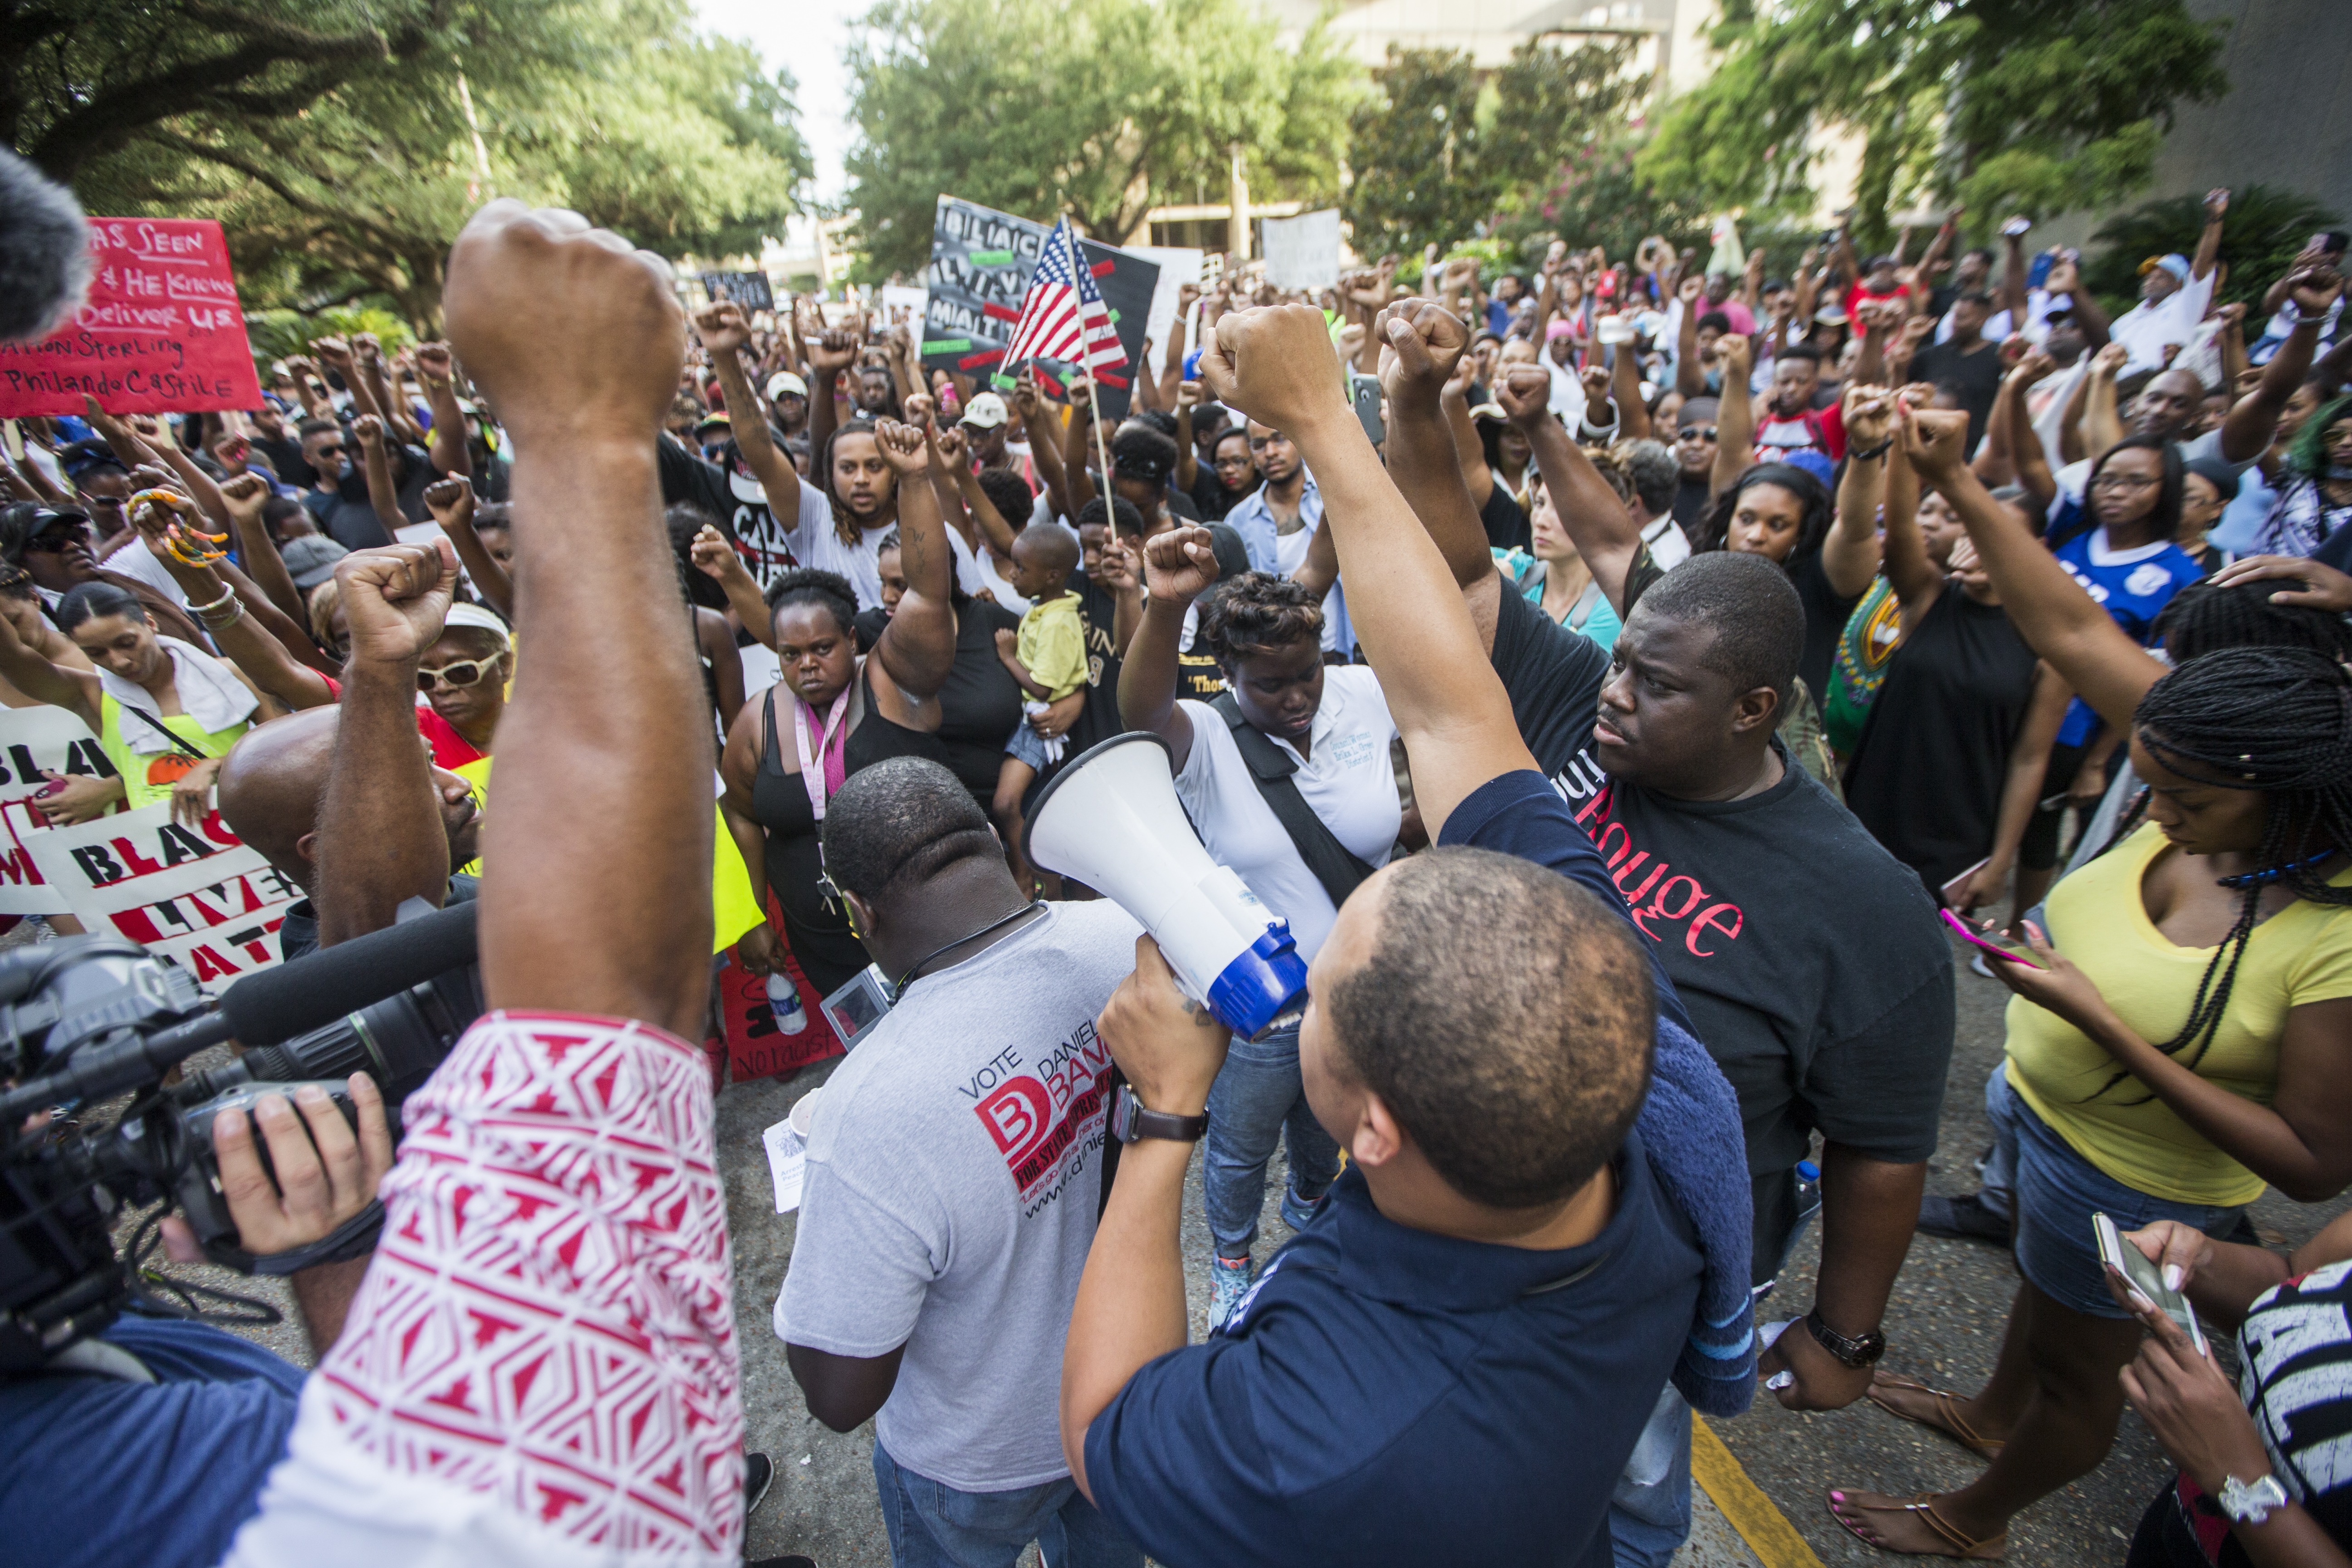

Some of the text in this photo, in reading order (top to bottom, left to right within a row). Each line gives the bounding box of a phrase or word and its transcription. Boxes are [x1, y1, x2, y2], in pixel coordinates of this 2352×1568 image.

[125, 267, 162, 296] HE
[1574, 784, 1743, 957] Rouge
[958, 1020, 1098, 1100] VOTE DANIEL
[1047, 1036, 1112, 1113] BAN
[1015, 1159, 1042, 1189] FOR
[1039, 1122, 1072, 1167] STATE
[1045, 1169, 1058, 1186] go
